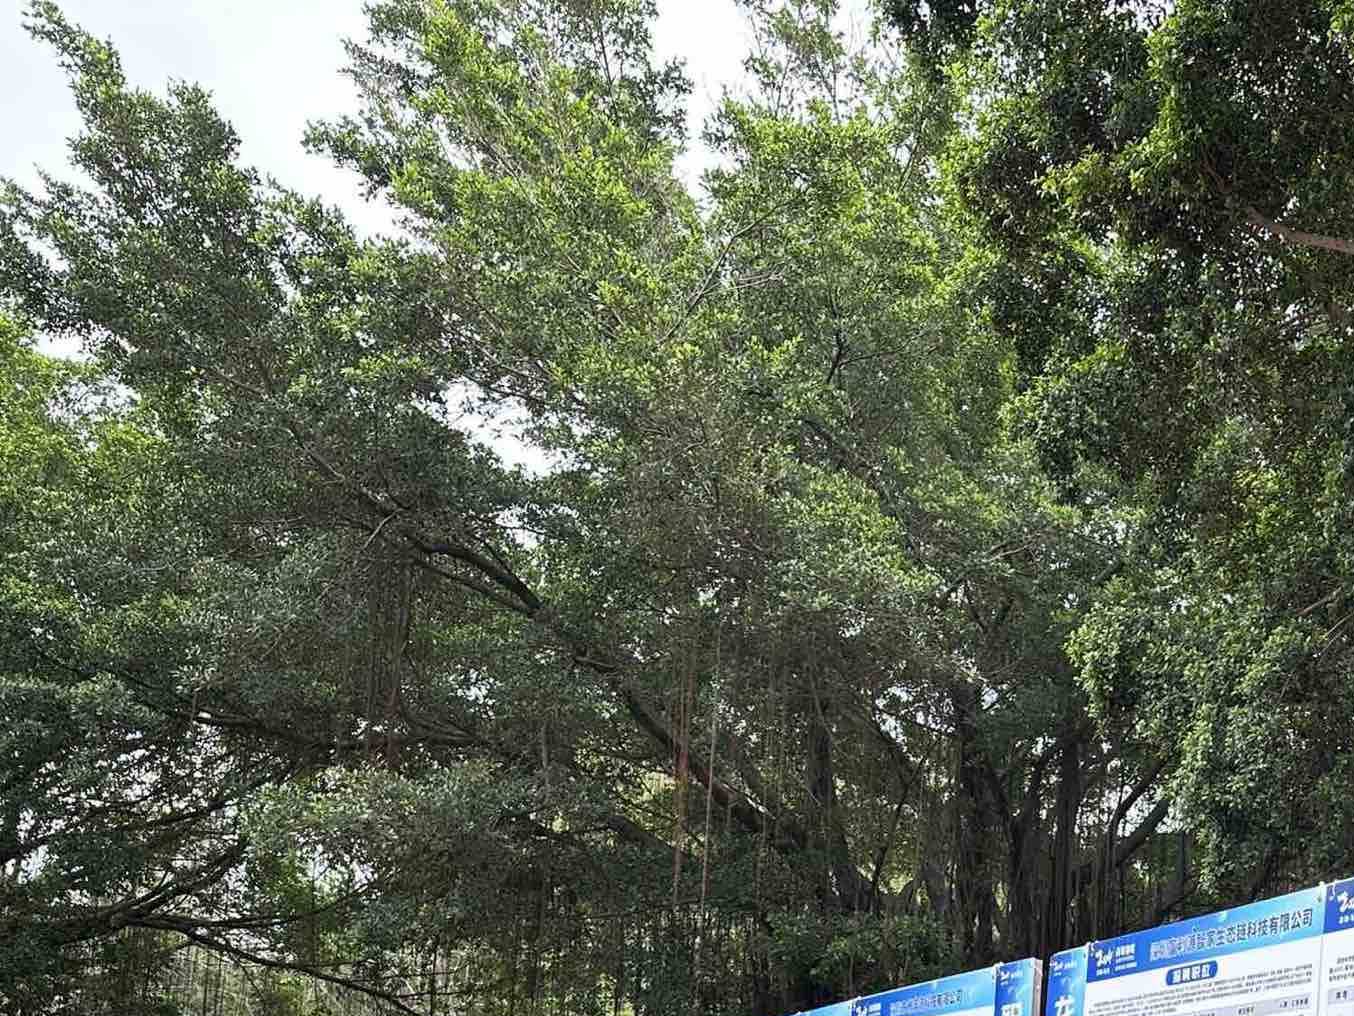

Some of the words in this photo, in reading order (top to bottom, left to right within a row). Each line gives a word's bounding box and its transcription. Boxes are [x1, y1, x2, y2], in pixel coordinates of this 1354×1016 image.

[1150, 908, 1313, 962] 家生态链科技有限公司
